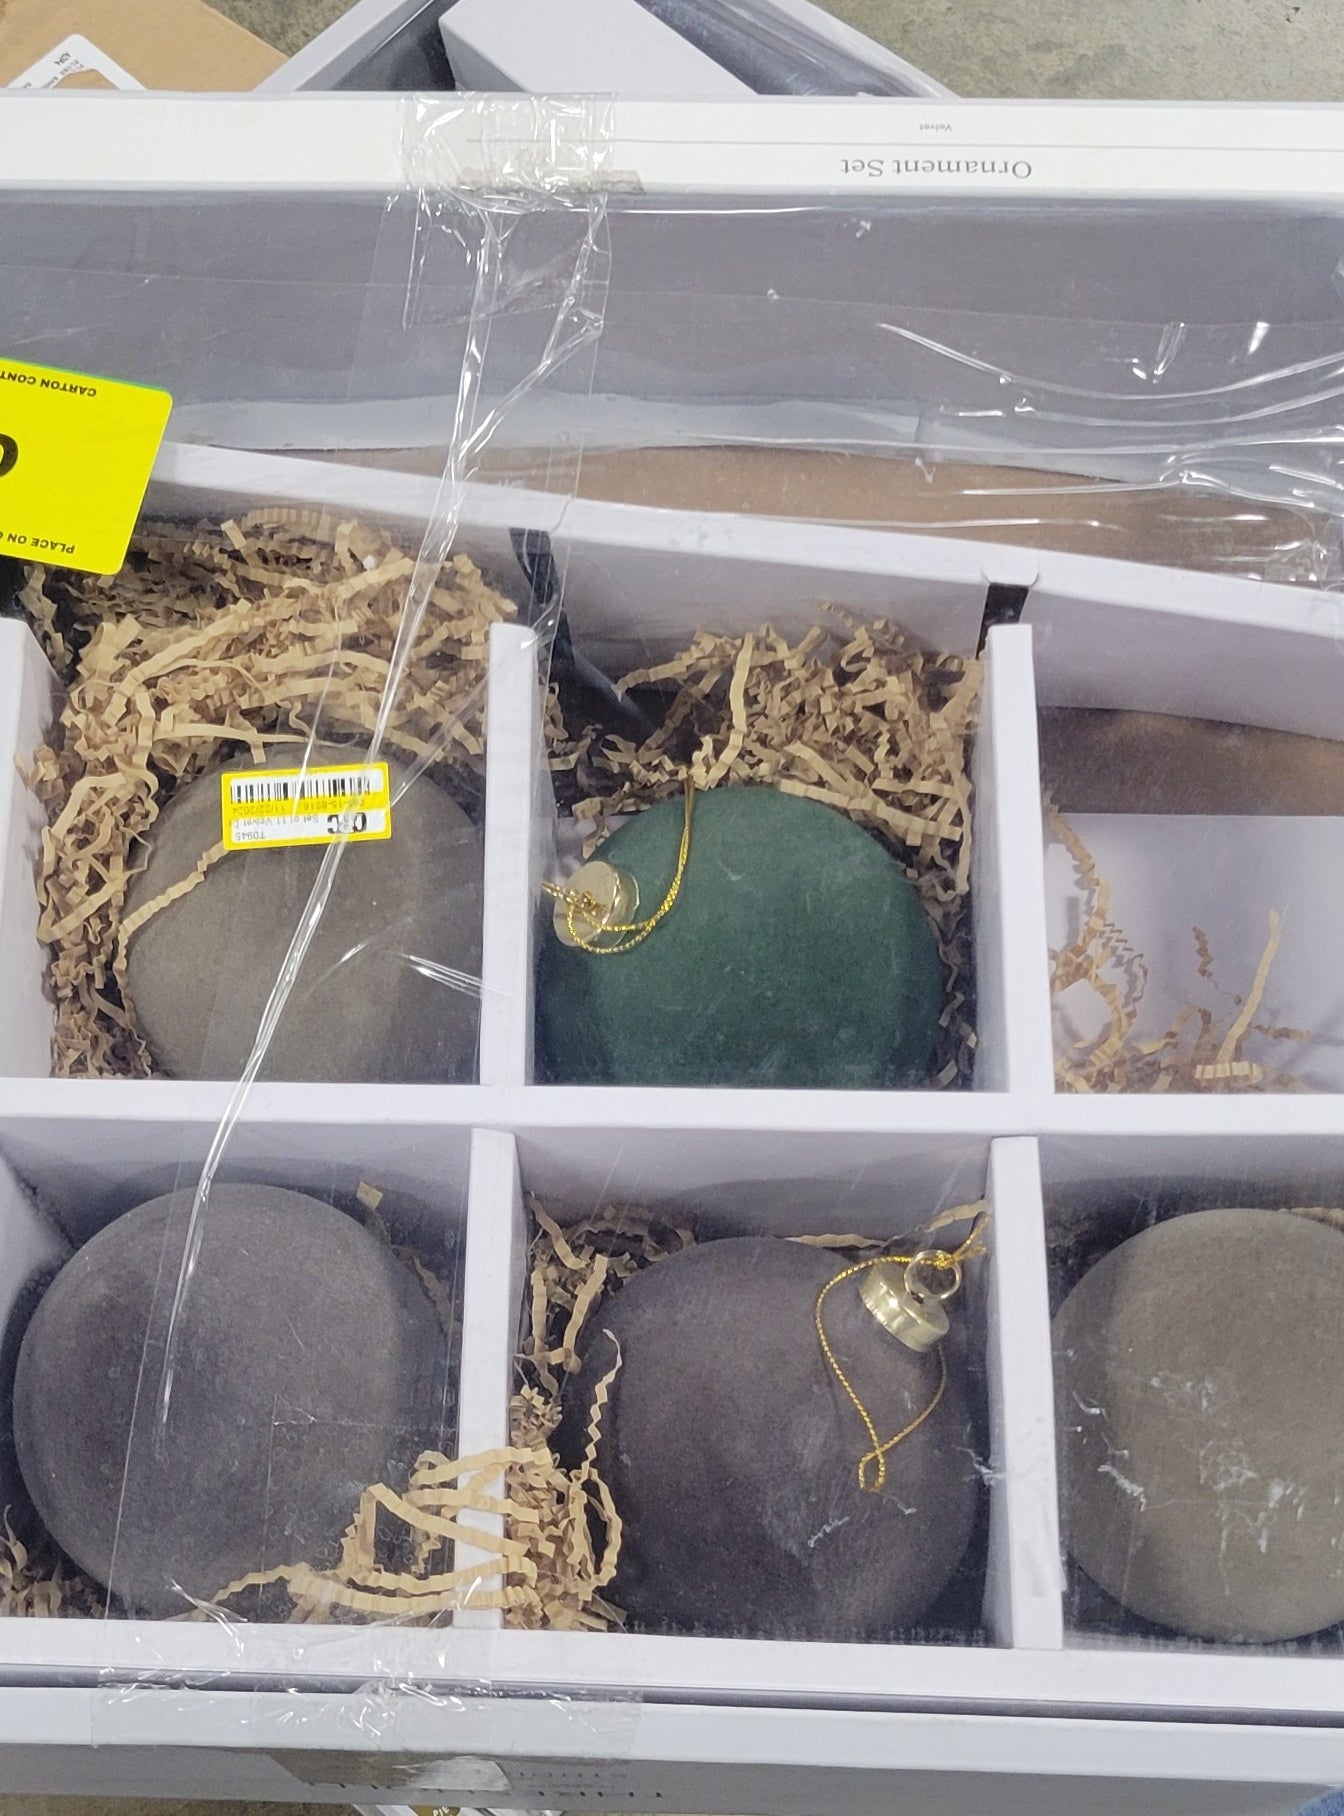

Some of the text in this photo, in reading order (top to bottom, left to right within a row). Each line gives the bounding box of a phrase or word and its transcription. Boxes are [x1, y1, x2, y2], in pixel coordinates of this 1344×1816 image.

[918, 122, 952, 132] Velvet
[839, 158, 1032, 179] Ornament Set
[40, 376, 98, 397] CARTON
[6, 533, 27, 544] ON
[31, 538, 75, 555] PLACE
